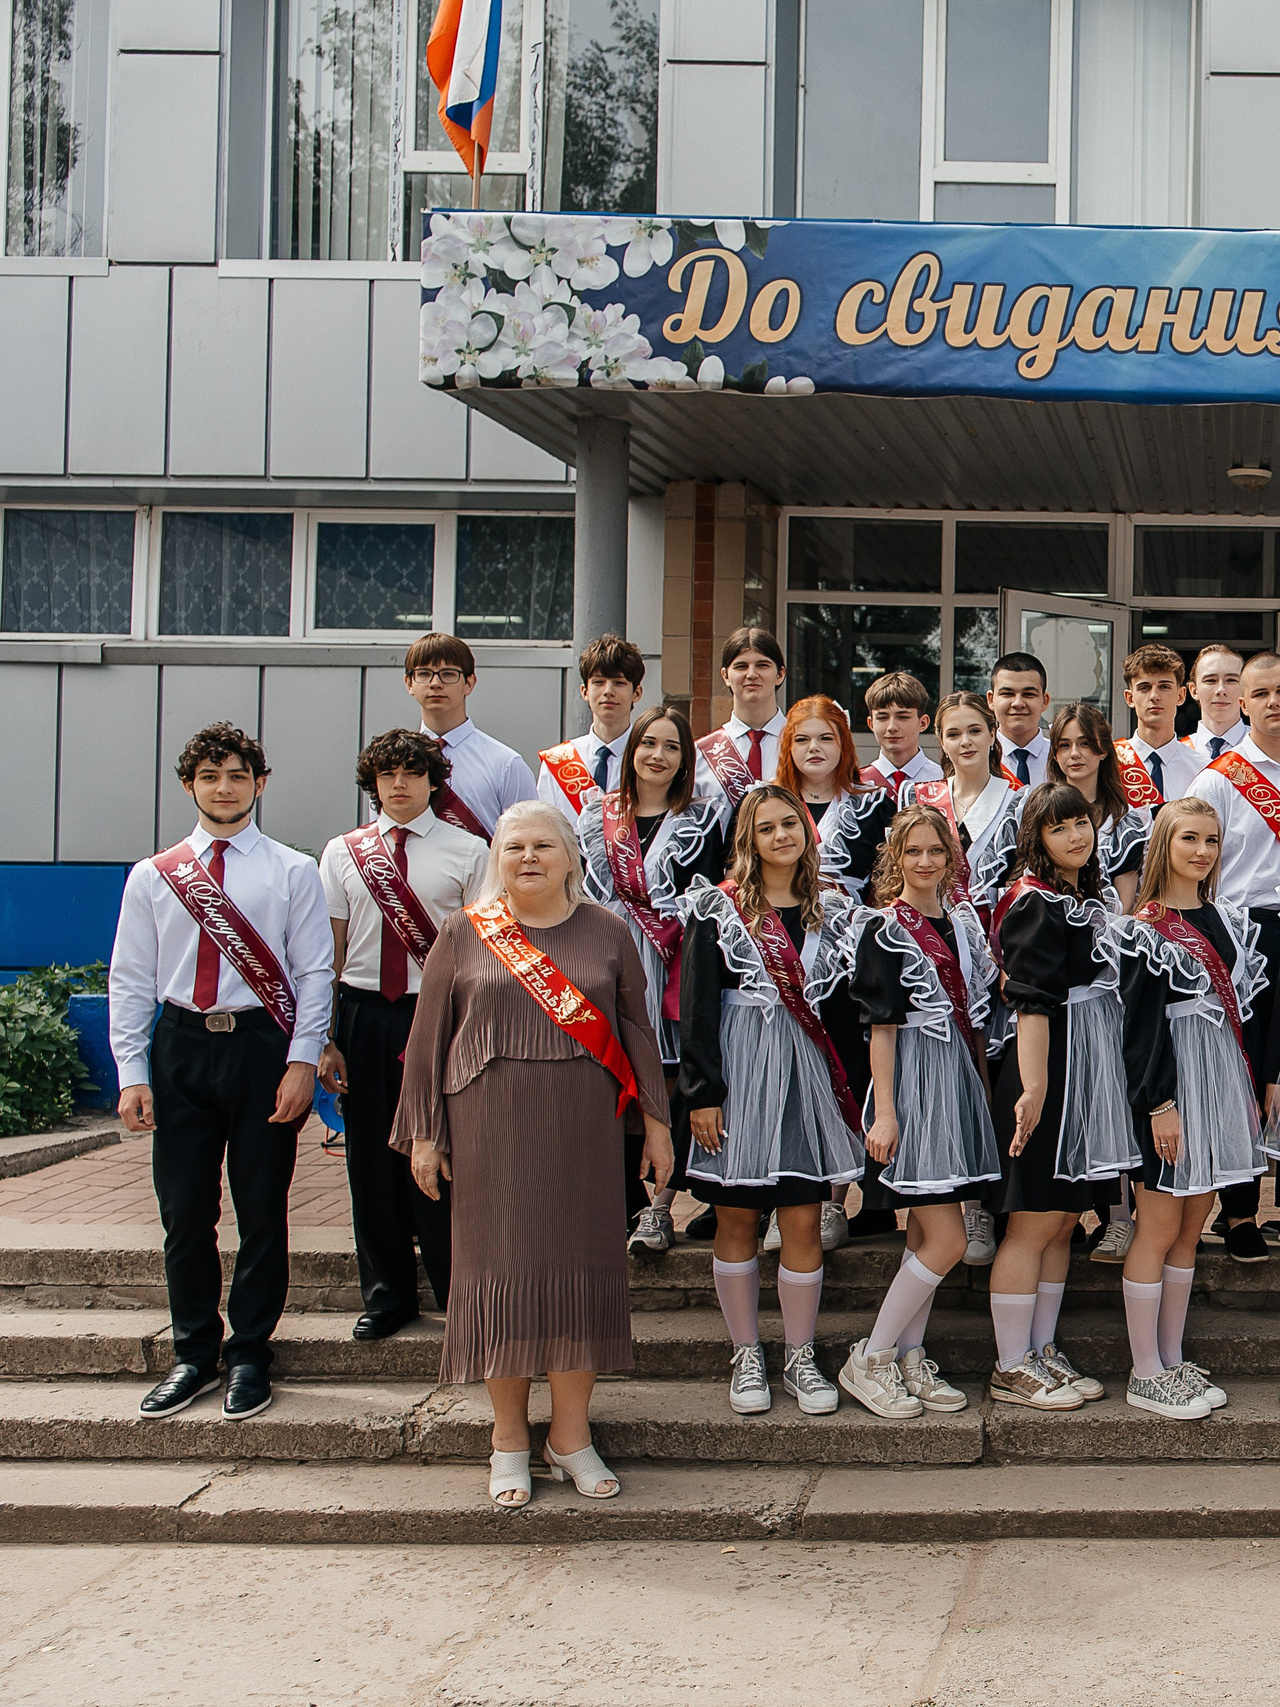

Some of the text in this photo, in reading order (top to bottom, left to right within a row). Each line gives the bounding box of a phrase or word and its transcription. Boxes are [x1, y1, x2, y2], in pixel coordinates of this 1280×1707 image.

[662, 247, 802, 344] До
[186, 880, 270, 979] Выпускник
[364, 854, 430, 950] Выпускник
